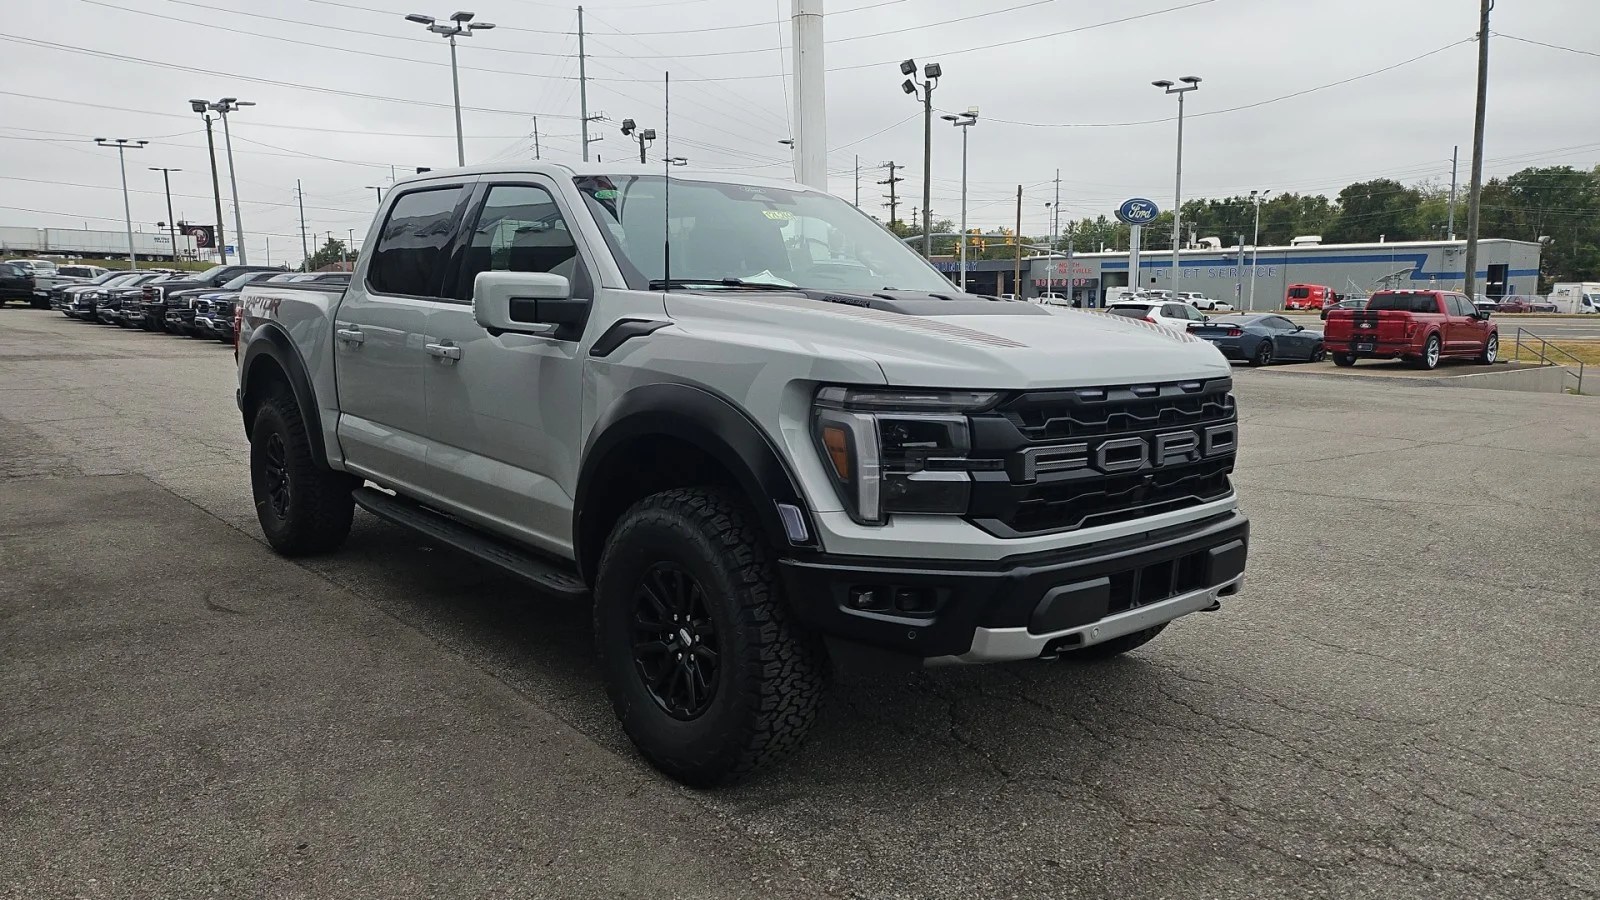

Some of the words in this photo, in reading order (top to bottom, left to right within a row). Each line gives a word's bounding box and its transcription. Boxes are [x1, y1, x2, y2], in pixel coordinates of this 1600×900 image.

[1128, 202, 1152, 218] Ford
[1156, 268, 1200, 280] FLET
[1061, 279, 1086, 287] SOP
[244, 296, 282, 318] RAPTOR
[1017, 423, 1238, 482] FORD
